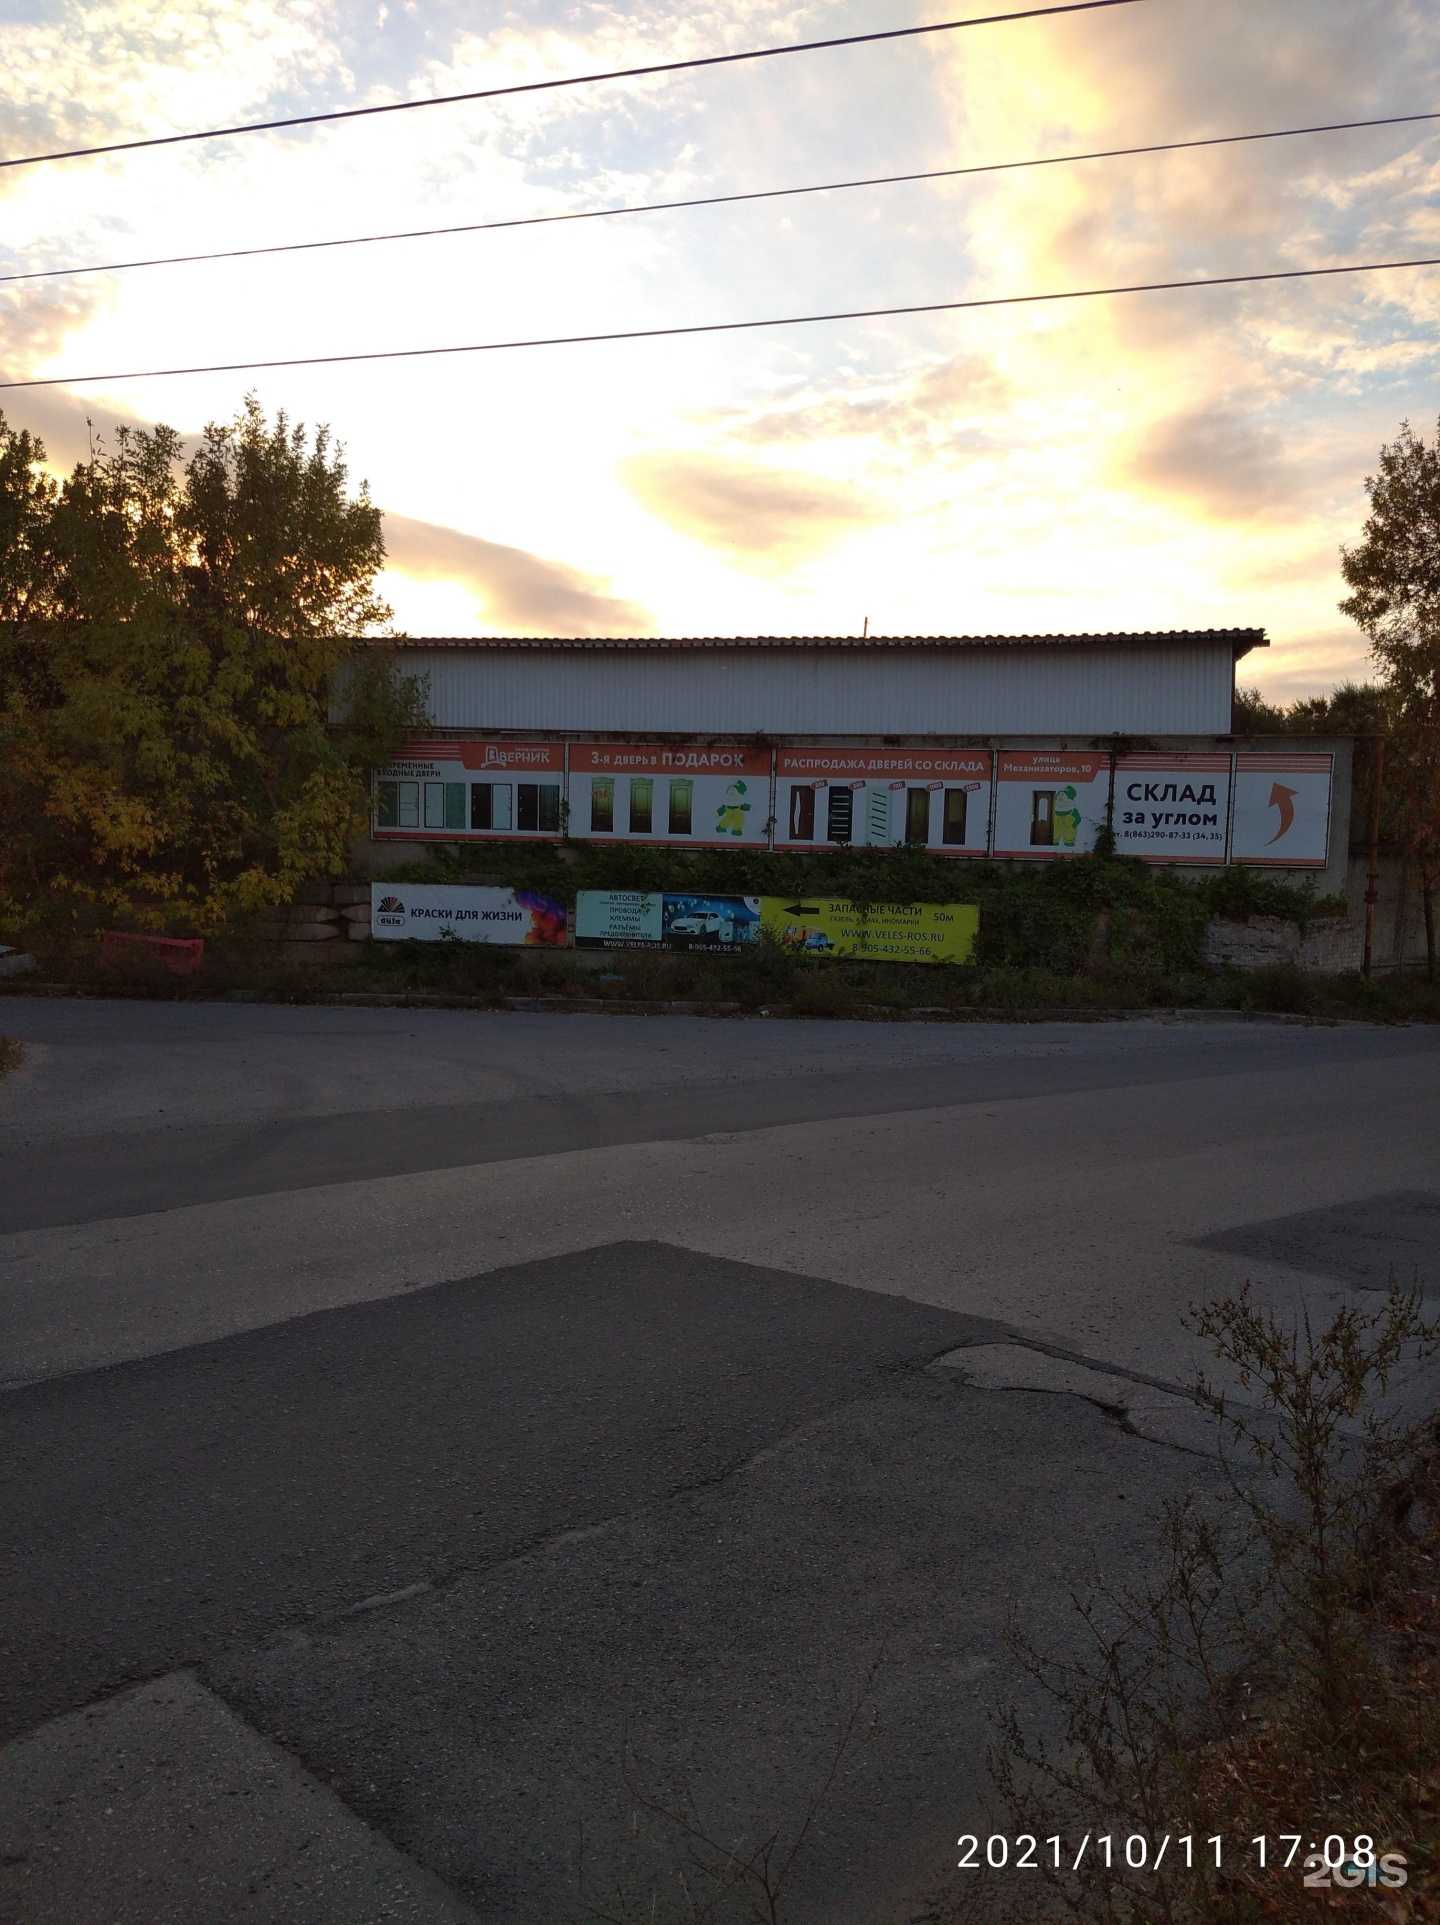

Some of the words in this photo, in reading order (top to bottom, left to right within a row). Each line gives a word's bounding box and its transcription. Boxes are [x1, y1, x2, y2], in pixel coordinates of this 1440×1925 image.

[661, 752, 744, 768] ПОДАРОК
[784, 757, 866, 770] РАСПРОДАЖА
[868, 757, 914, 771] ДВЕРЕЙ
[915, 759, 932, 771] СО
[934, 760, 985, 773] СКЛАДА
[1126, 783, 1217, 805] СКЛАД
[1122, 812, 1146, 825] за
[1151, 812, 1218, 829] углом
[410, 908, 453, 919] КРАСКИ
[455, 909, 478, 921] ДЛЯ
[481, 910, 523, 922] ЖИЗНИ
